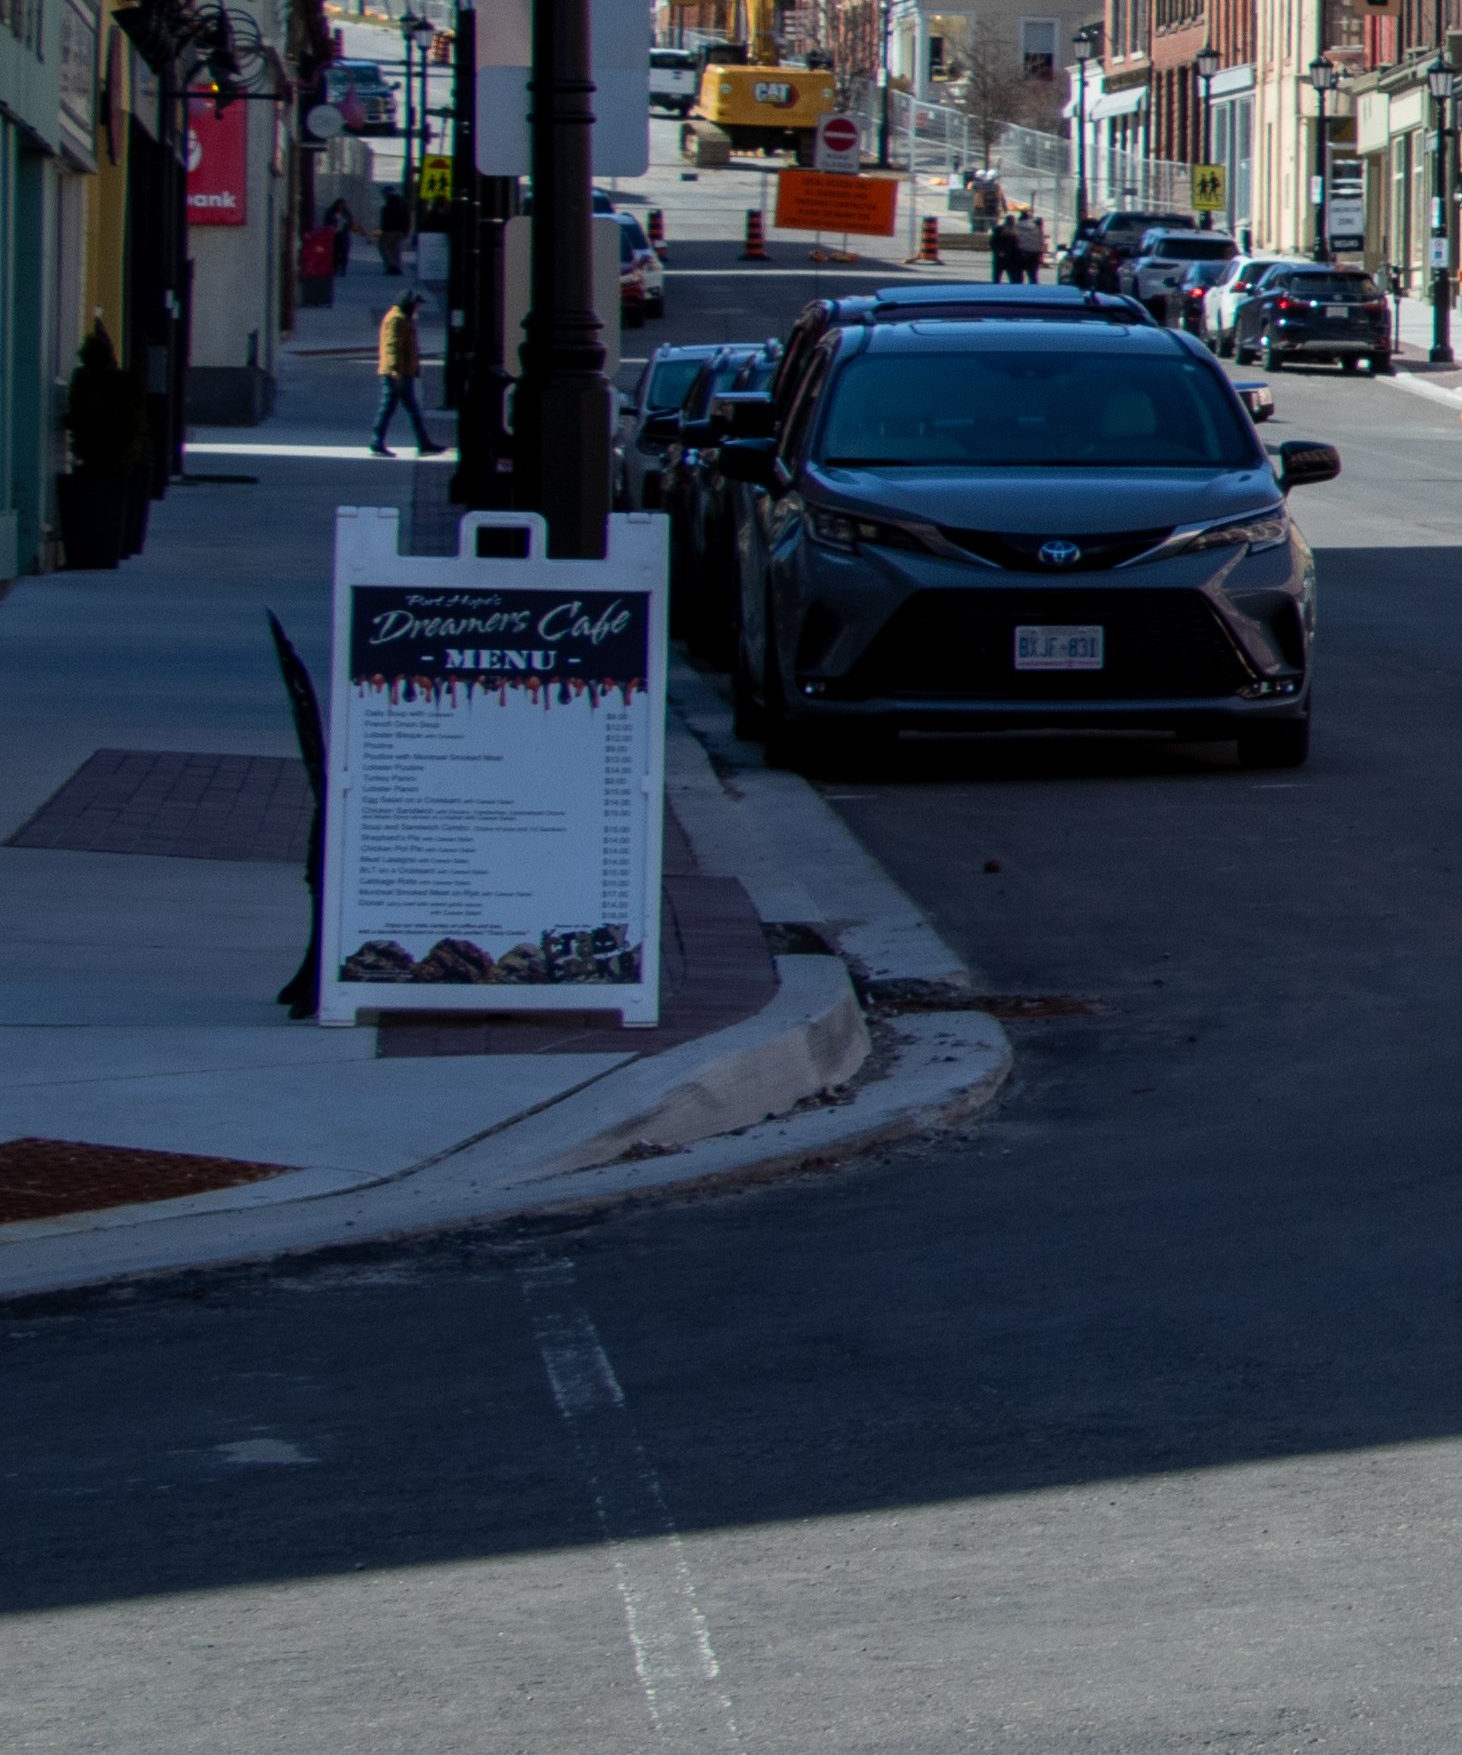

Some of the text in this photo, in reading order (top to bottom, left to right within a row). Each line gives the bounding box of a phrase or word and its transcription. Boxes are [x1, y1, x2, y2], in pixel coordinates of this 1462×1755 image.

[756, 83, 789, 103] CAT
[369, 598, 631, 645] Dreamers Cafe
[445, 649, 557, 670] MENU
